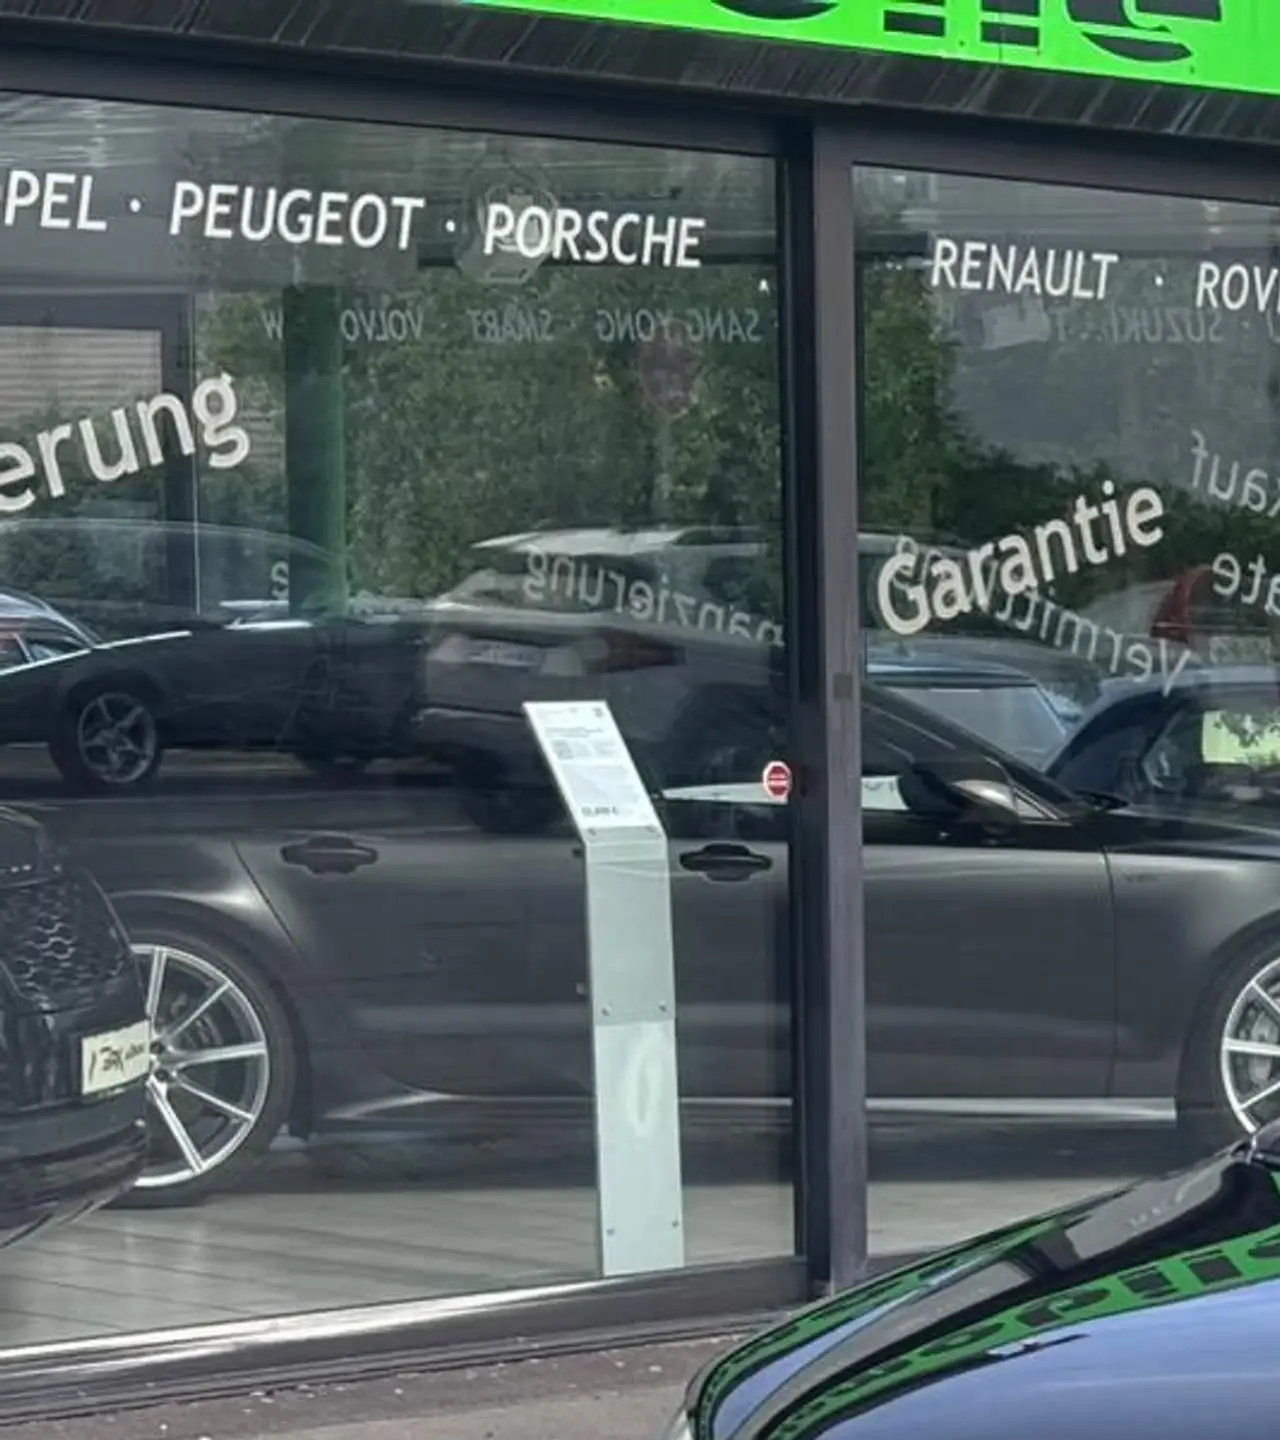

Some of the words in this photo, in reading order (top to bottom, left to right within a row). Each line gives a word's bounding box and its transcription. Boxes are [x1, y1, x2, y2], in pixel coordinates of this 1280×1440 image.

[0, 169, 107, 231] PEL
[170, 181, 425, 251] PEUGEOT
[483, 202, 705, 269] PORSCHE
[929, 239, 1118, 300] RENAULT
[878, 479, 1165, 636] Garantie
